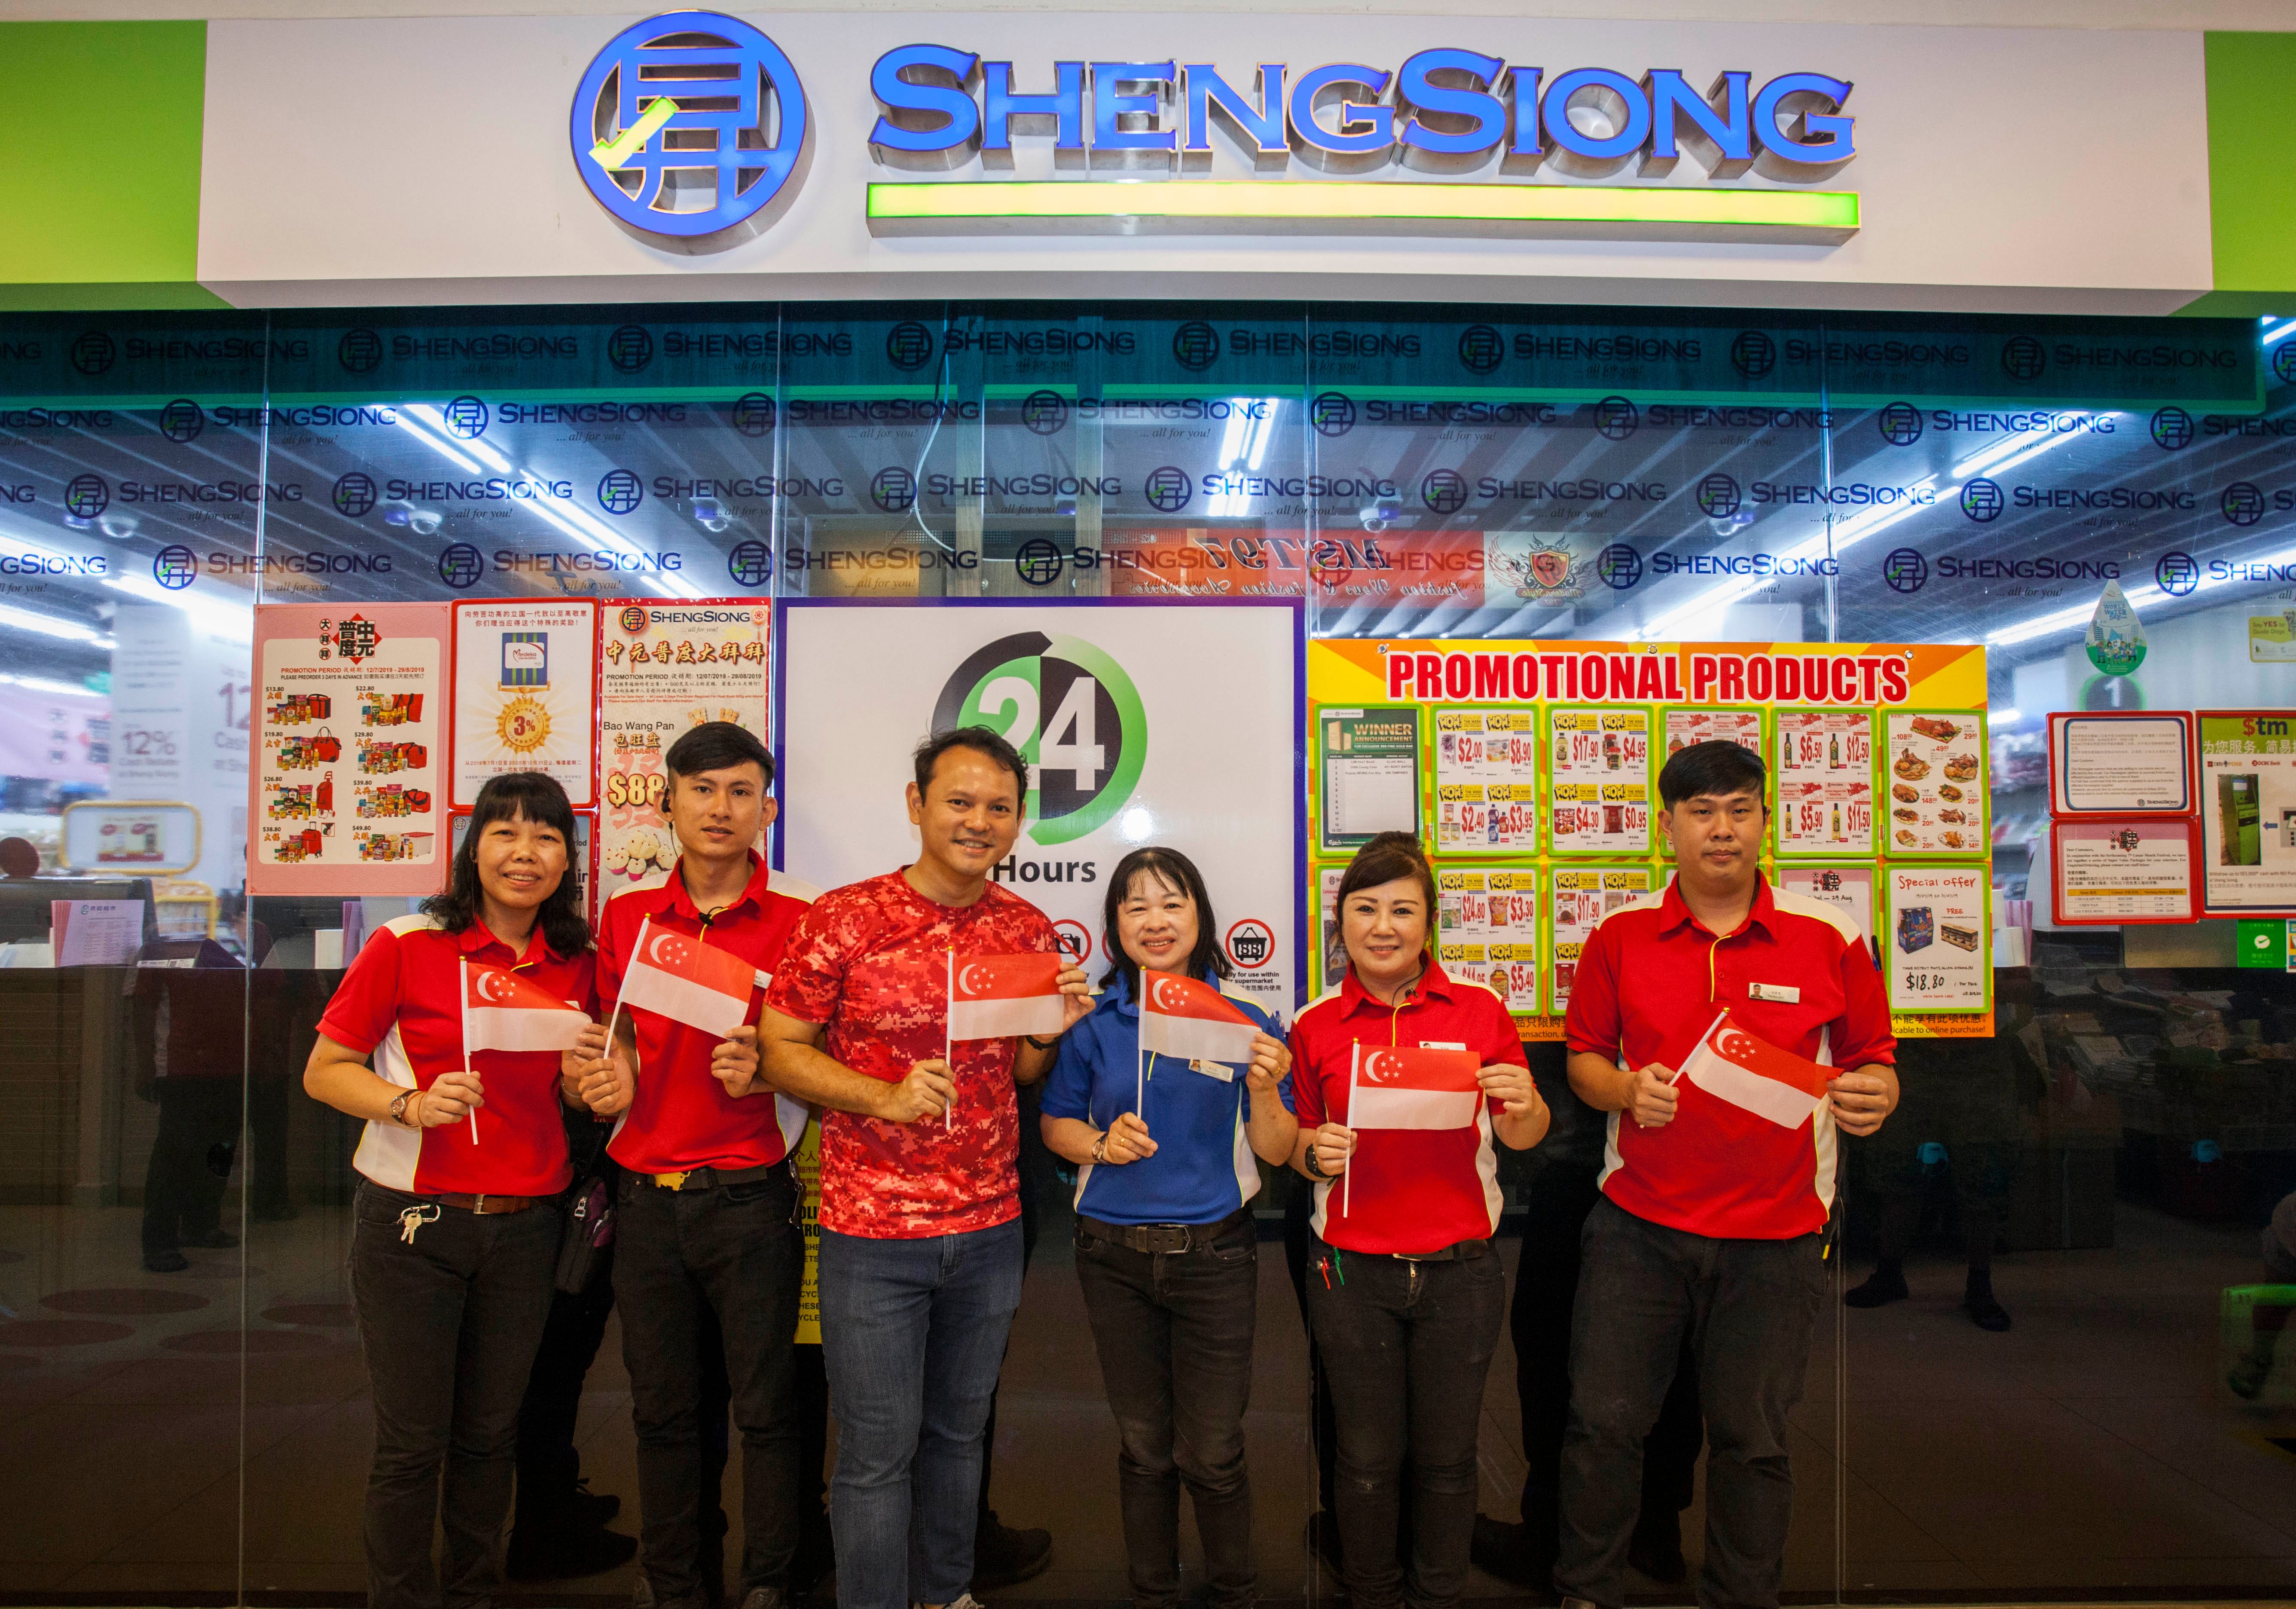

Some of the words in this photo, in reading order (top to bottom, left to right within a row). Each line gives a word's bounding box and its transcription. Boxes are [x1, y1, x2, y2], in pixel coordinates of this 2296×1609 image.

[465, 610, 587, 618] 向劳苦功高的立国一代致以至高敬意
[606, 640, 765, 665] 中元普度大拜拜
[1389, 653, 1683, 700] PROMOTIONAL
[1694, 656, 1908, 702] PRODUCTS
[514, 716, 535, 736] 3%
[604, 722, 623, 730] Bao
[626, 722, 653, 732] Wang
[656, 722, 674, 730] Pan
[614, 732, 660, 747] 包旺盘
[978, 675, 1105, 791] 24
[1354, 723, 1413, 735] WINNER
[2243, 717, 2288, 737] $tm
[1458, 736, 1482, 765] $2.00
[1511, 736, 1531, 768] $8.90
[1573, 734, 1598, 764] $17.90
[1623, 736, 1646, 764] $4.95
[1800, 734, 1822, 765] $6.50
[1847, 734, 1869, 765] $12.50
[1462, 804, 1484, 835] $2.40
[1510, 804, 1533, 836] $3.95
[1576, 806, 1599, 834] $4.30
[1625, 806, 1646, 831] $0.95
[1801, 804, 1823, 834] $5.90
[1847, 804, 1870, 834] $11.50
[993, 854, 1096, 884] Hours
[1898, 875, 1939, 890] Special
[1943, 876, 1976, 888] offer
[1462, 894, 1485, 924] $24.80
[1510, 894, 1533, 924] $3.30
[1577, 893, 1600, 922] $17.90
[1841, 895, 1853, 903] Aug
[1510, 964, 1534, 994] $5.40
[1906, 972, 1945, 991] $18.80
[1950, 1026, 1985, 1036] purchase!
